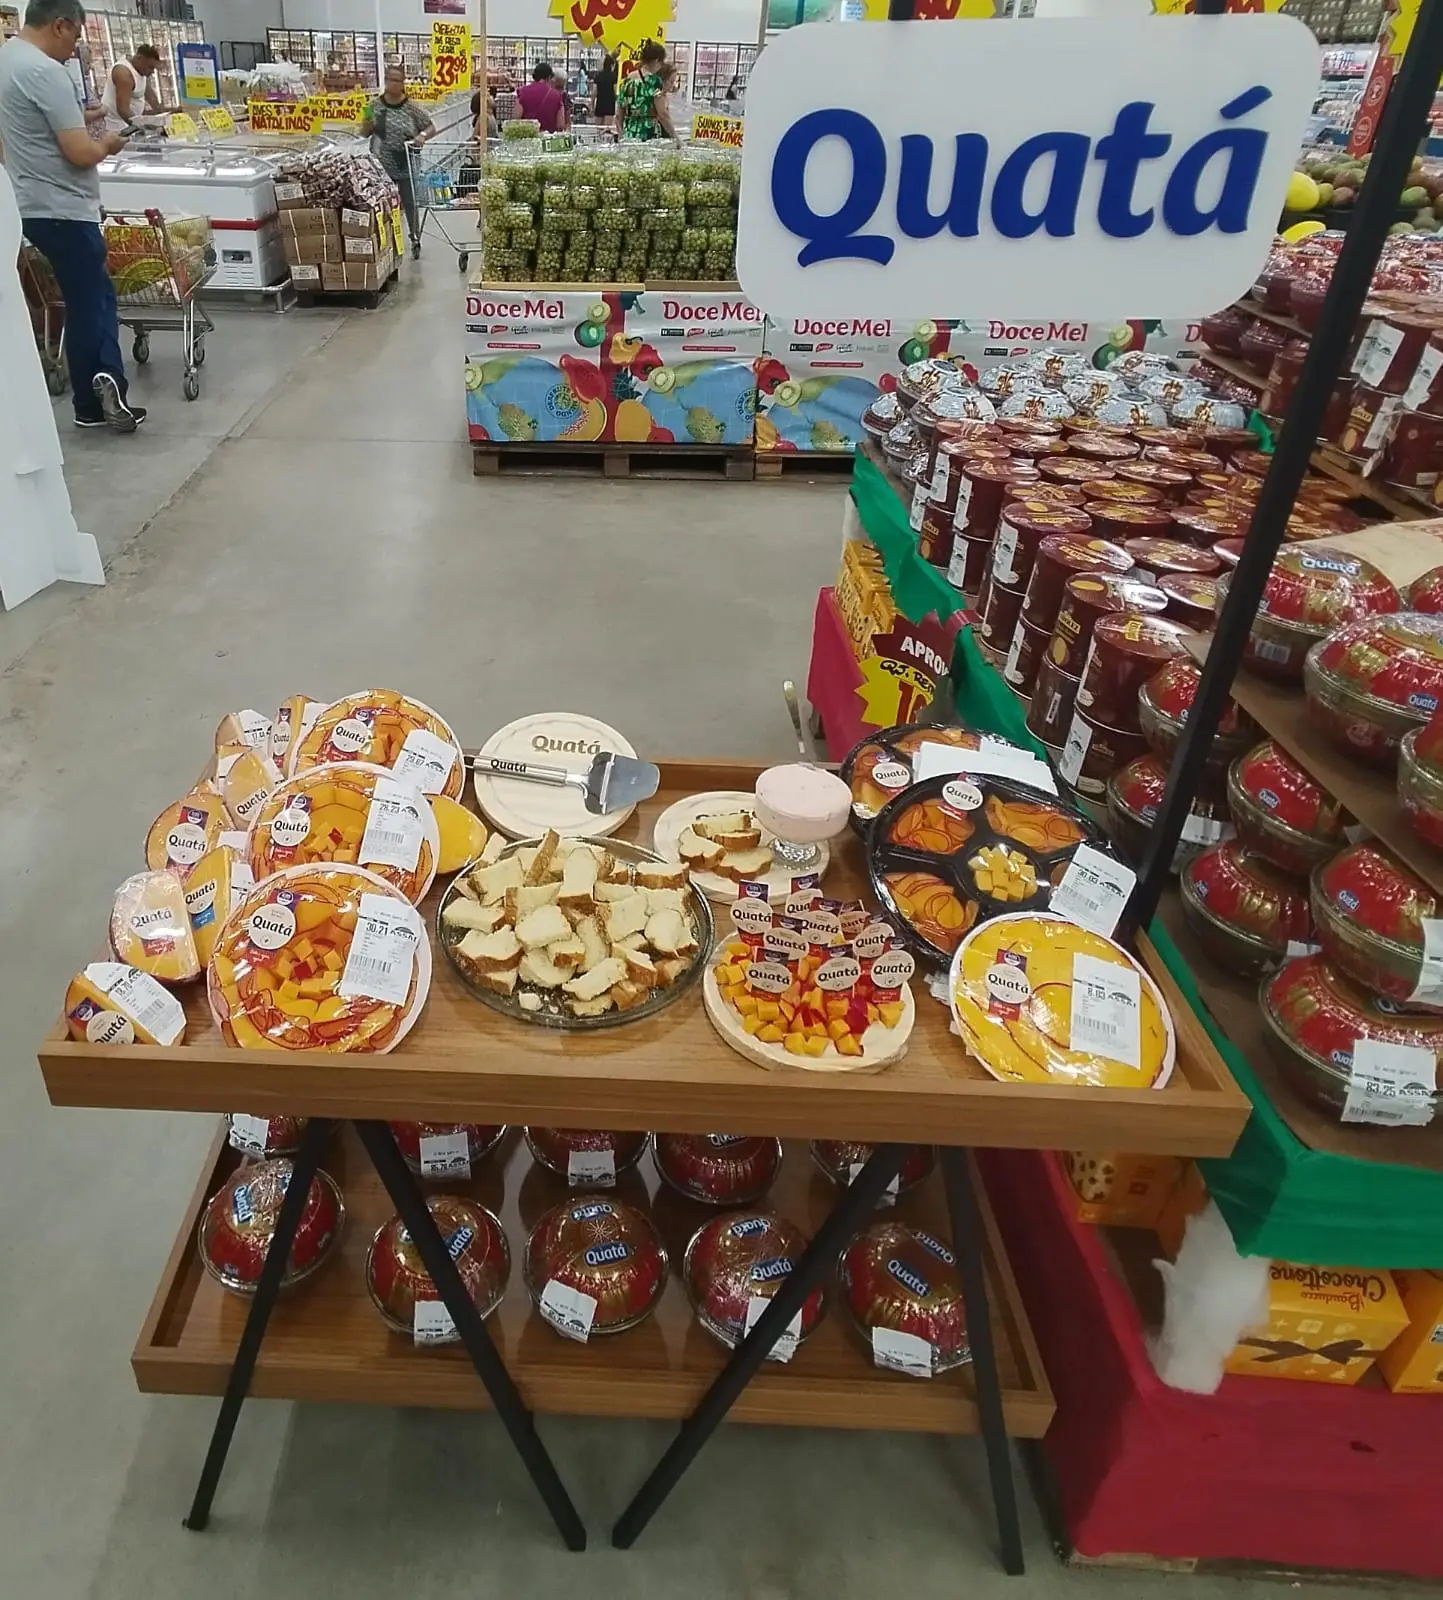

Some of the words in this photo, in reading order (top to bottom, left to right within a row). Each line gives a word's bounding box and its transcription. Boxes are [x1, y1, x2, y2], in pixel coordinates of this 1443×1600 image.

[433, 22, 466, 36] OFERTA
[252, 104, 272, 116] AVES
[321, 108, 356, 121] TALINAS
[252, 116, 311, 132] NATALINAS
[698, 116, 722, 130] SUINOS
[771, 85, 1274, 268] Quatá
[466, 297, 521, 318] Doce
[525, 298, 565, 320] Mel
[663, 301, 718, 322] Doce
[851, 319, 891, 336] Mel
[988, 320, 1044, 340] Doce
[1048, 322, 1088, 342] Mel
[1302, 558, 1358, 575] Quatá
[900, 636, 950, 676] APROV
[1408, 694, 1438, 711] Quatá
[335, 726, 367, 745] Quatá
[531, 734, 601, 755] Quatá
[490, 758, 527, 773] Quatá
[874, 769, 908, 781] Quatá
[236, 789, 268, 816] Quatá
[946, 784, 981, 806] Quatá
[274, 818, 308, 834] Quatá
[168, 834, 206, 852] Quatá
[185, 881, 216, 904] Quatá
[732, 908, 772, 924] Quatá
[787, 903, 810, 914] Qua
[131, 909, 172, 928] Quatá
[252, 915, 293, 938] Quatá
[801, 920, 840, 934] Quatá
[366, 922, 388, 937] 30.21
[766, 934, 807, 950] Quatá
[748, 968, 790, 986] Quatá
[818, 966, 860, 982] Quatá
[874, 962, 913, 975] Quatá
[988, 974, 1030, 994] Quatá
[1332, 1050, 1353, 1066] Quat
[1366, 1081, 1396, 1098] 83.25
[234, 1186, 253, 1222] Quatá
[572, 1204, 614, 1220] Quatá
[732, 1218, 771, 1237] Quatá
[449, 1226, 474, 1261] uatá
[915, 1230, 955, 1266] Quatá
[585, 1244, 628, 1264] Quatá
[752, 1258, 794, 1281] Quatá
[887, 1258, 929, 1296] Quatá
[1272, 1266, 1386, 1302] Chocottone
